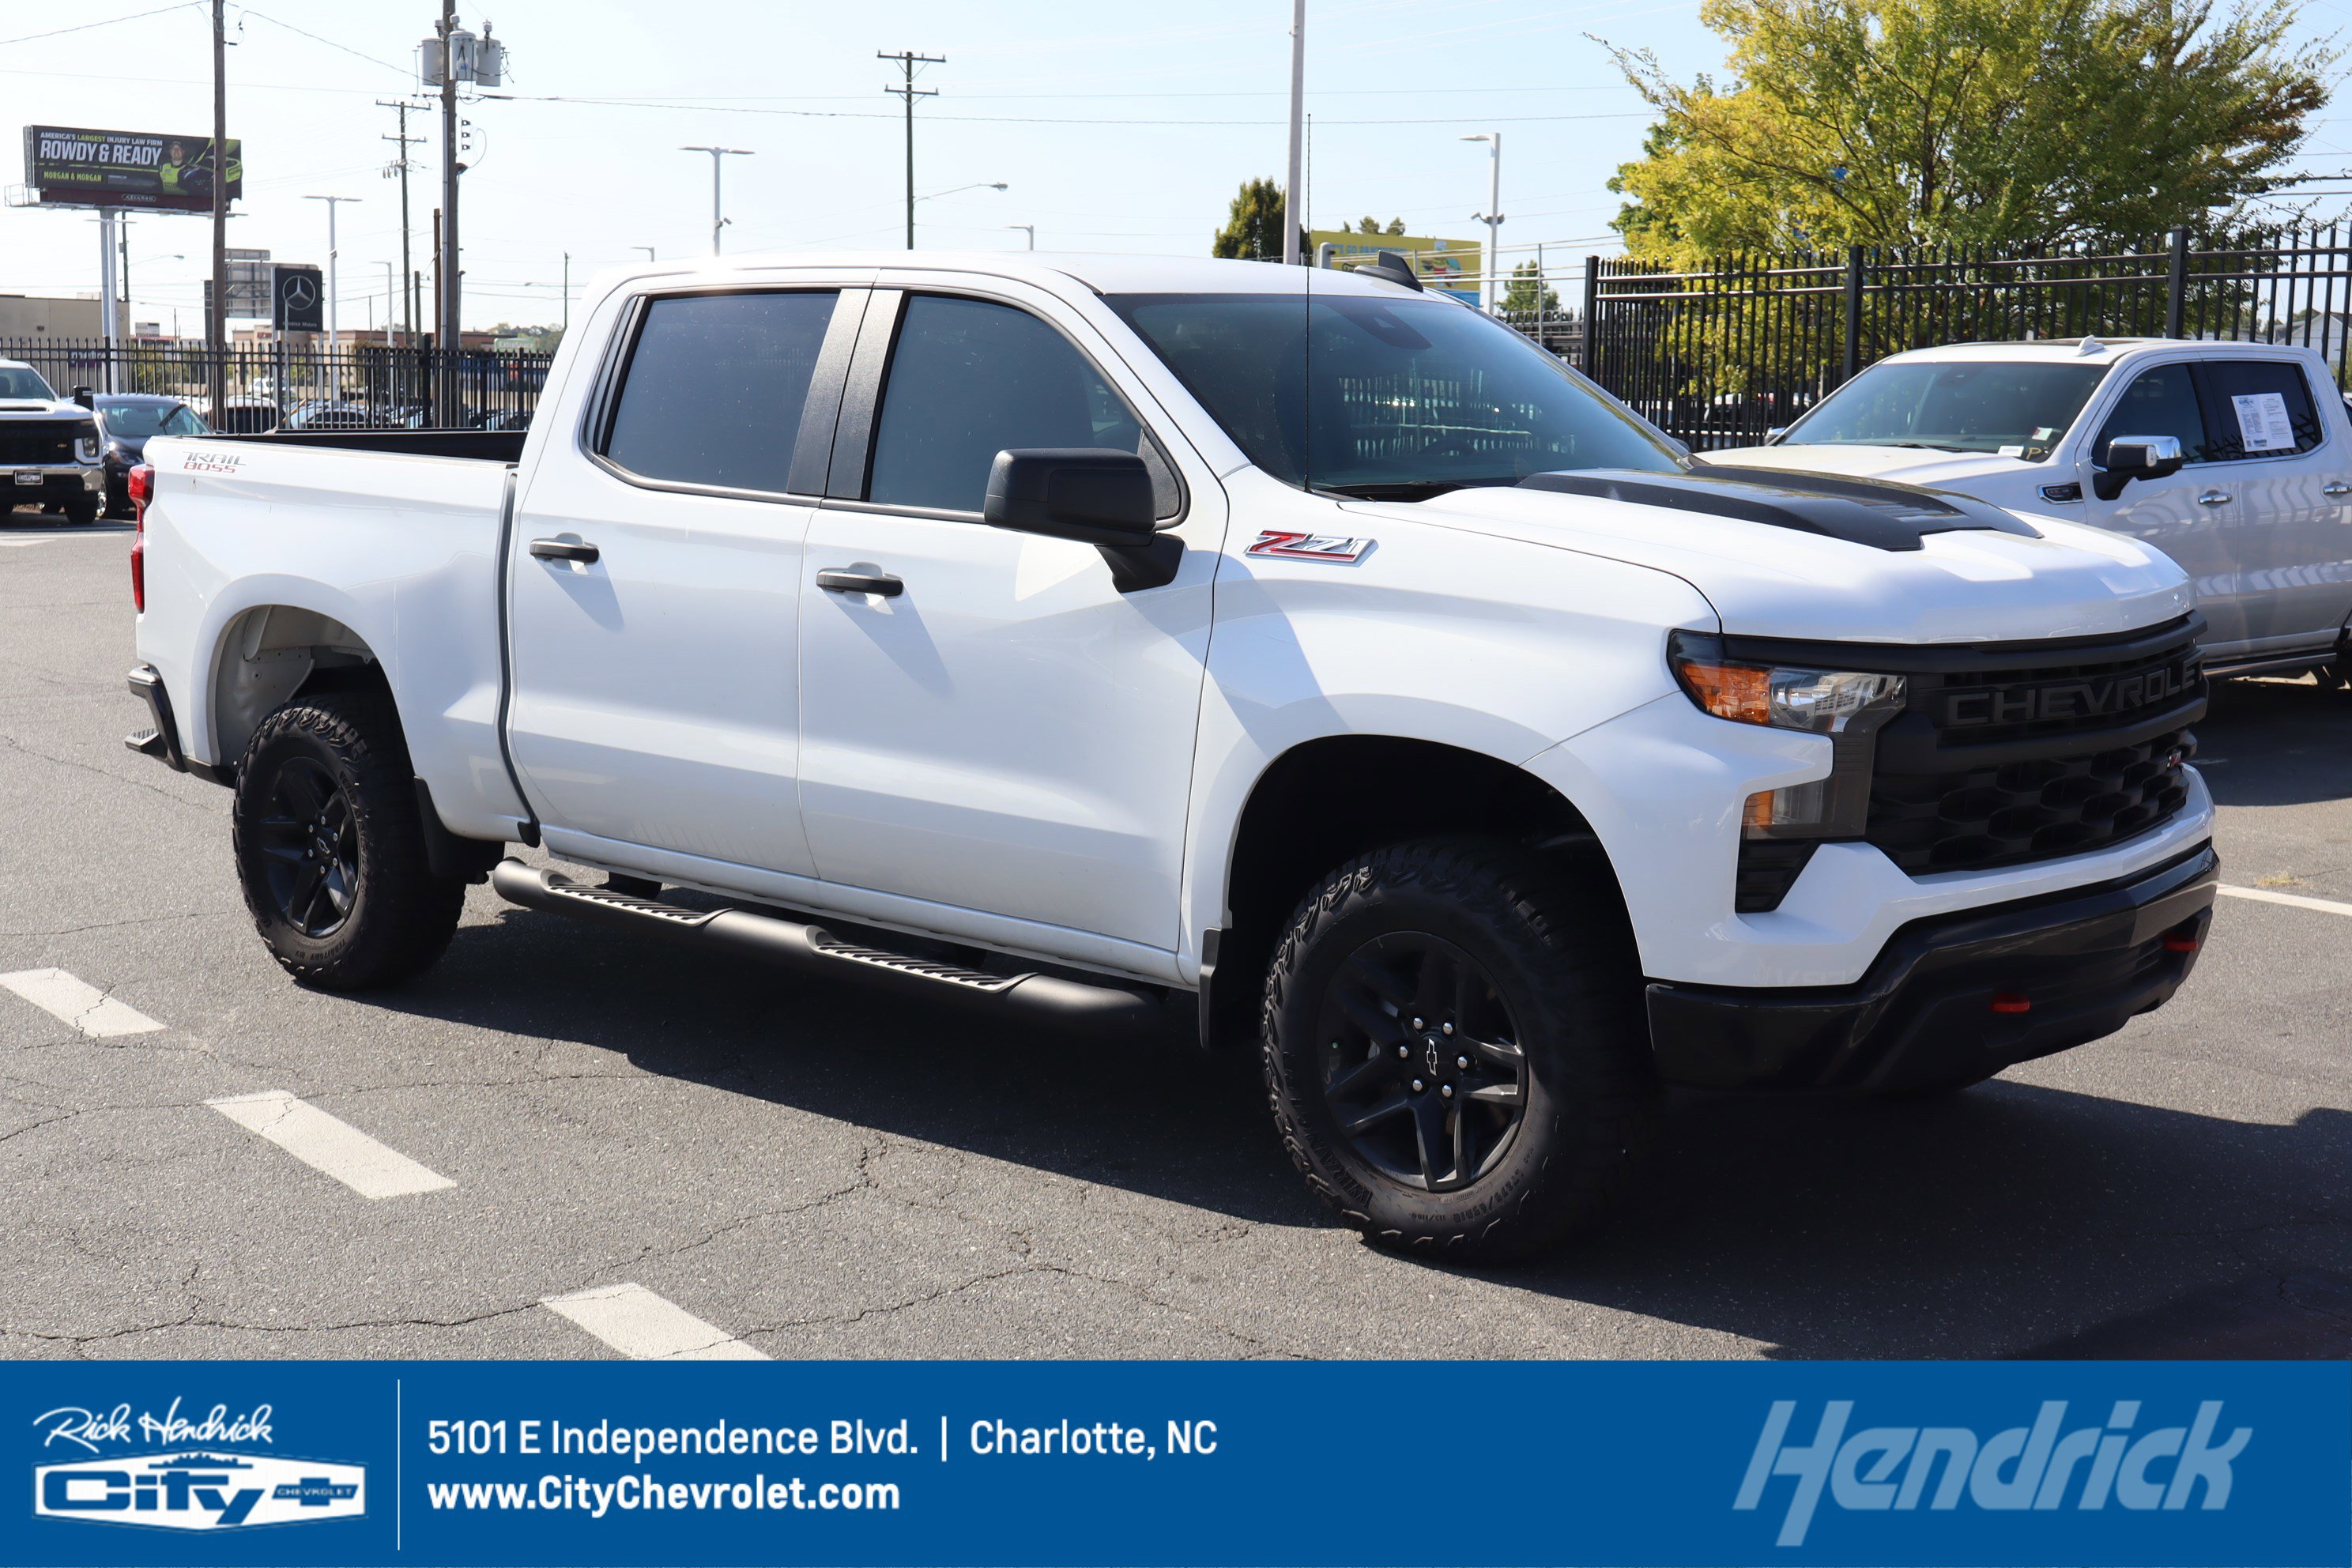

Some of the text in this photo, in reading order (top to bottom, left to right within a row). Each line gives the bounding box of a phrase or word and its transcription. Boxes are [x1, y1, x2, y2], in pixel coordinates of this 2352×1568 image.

[40, 132, 76, 141] AMERICA'S
[77, 134, 106, 143] LARGEST
[40, 139, 163, 166] ROWDY & READY
[43, 171, 70, 180] MORGAN
[76, 172, 102, 182] MORGAN
[182, 451, 247, 466] TRAIL
[183, 462, 237, 473] BOSS
[1242, 530, 1377, 564] Z71
[1947, 652, 2204, 726] CHEVROLET
